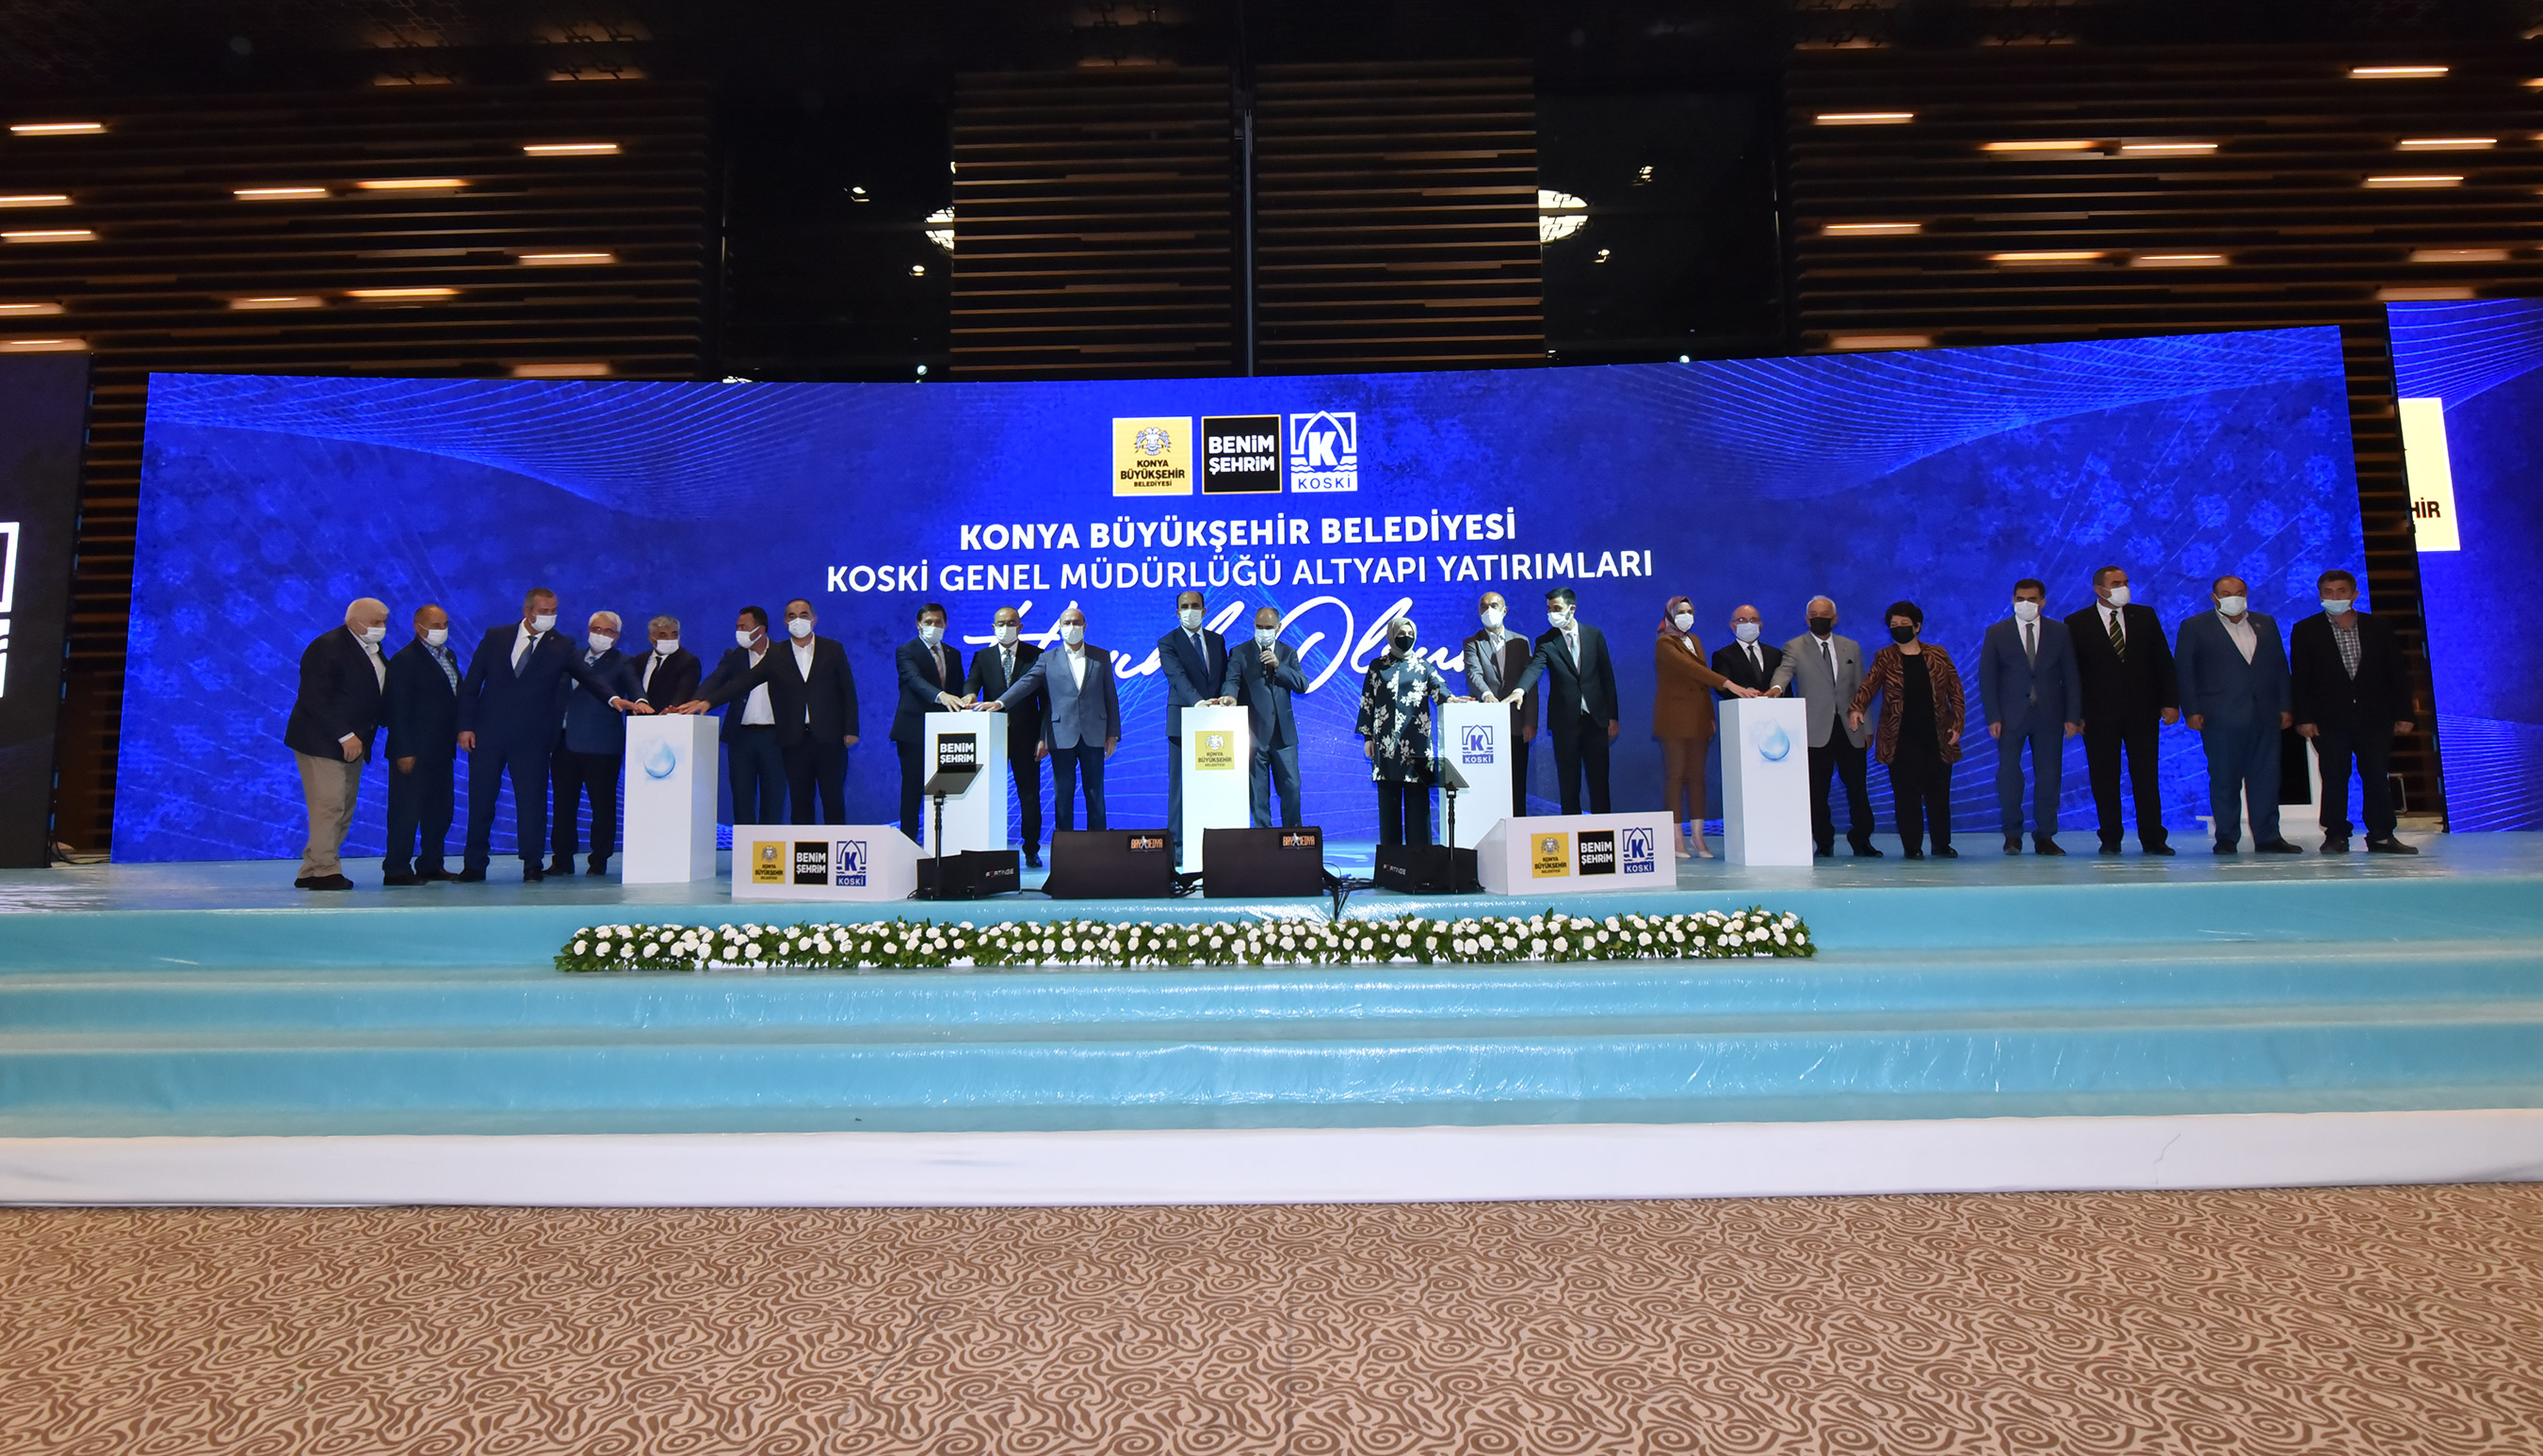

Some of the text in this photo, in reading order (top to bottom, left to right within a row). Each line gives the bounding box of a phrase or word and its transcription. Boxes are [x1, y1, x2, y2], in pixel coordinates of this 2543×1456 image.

[1137, 459, 1169, 468] KONYA
[1120, 467, 1185, 480] BÜYÜKŞEHİR
[1298, 473, 1351, 490] KOSKİ
[961, 507, 1516, 553] KONYA BÜYÜKŞEHİR BELEDİYESİ
[827, 550, 1652, 592] KOSKİ GENEL MÜDÜRLÜĞÜ ALTYAPI YATIRIMLARI
[1627, 862, 1652, 872] KOSKİ
[838, 877, 864, 885] KOSKİ
